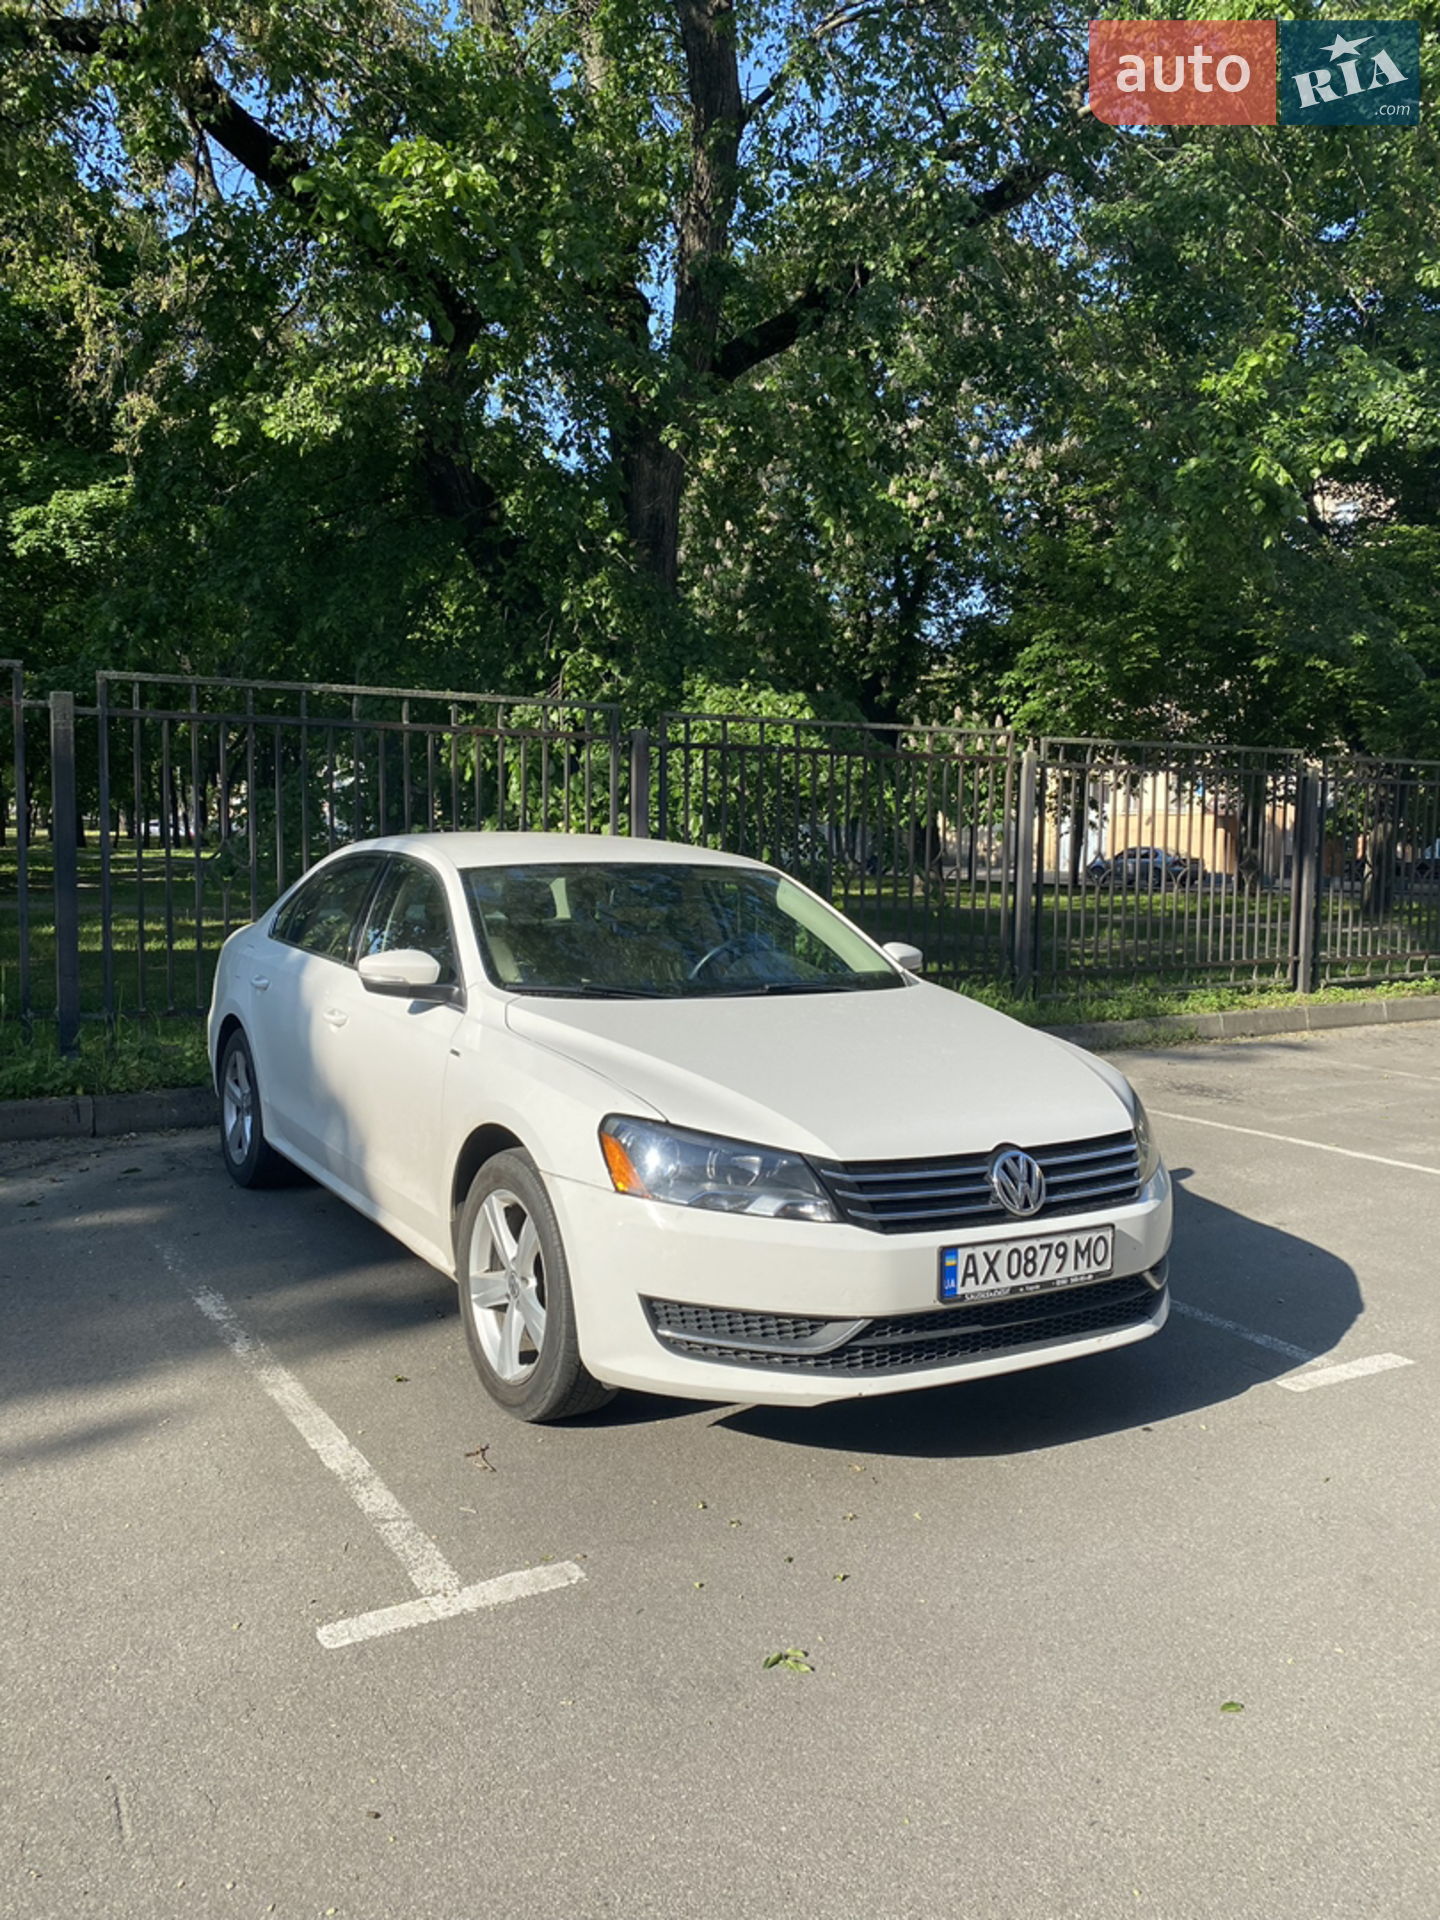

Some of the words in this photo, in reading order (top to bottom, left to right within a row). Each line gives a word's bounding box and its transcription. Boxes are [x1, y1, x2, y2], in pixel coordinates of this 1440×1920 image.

[960, 1249, 1002, 1288] AX
[1007, 1241, 1068, 1280] 0879
[1074, 1235, 1109, 1271] MO
